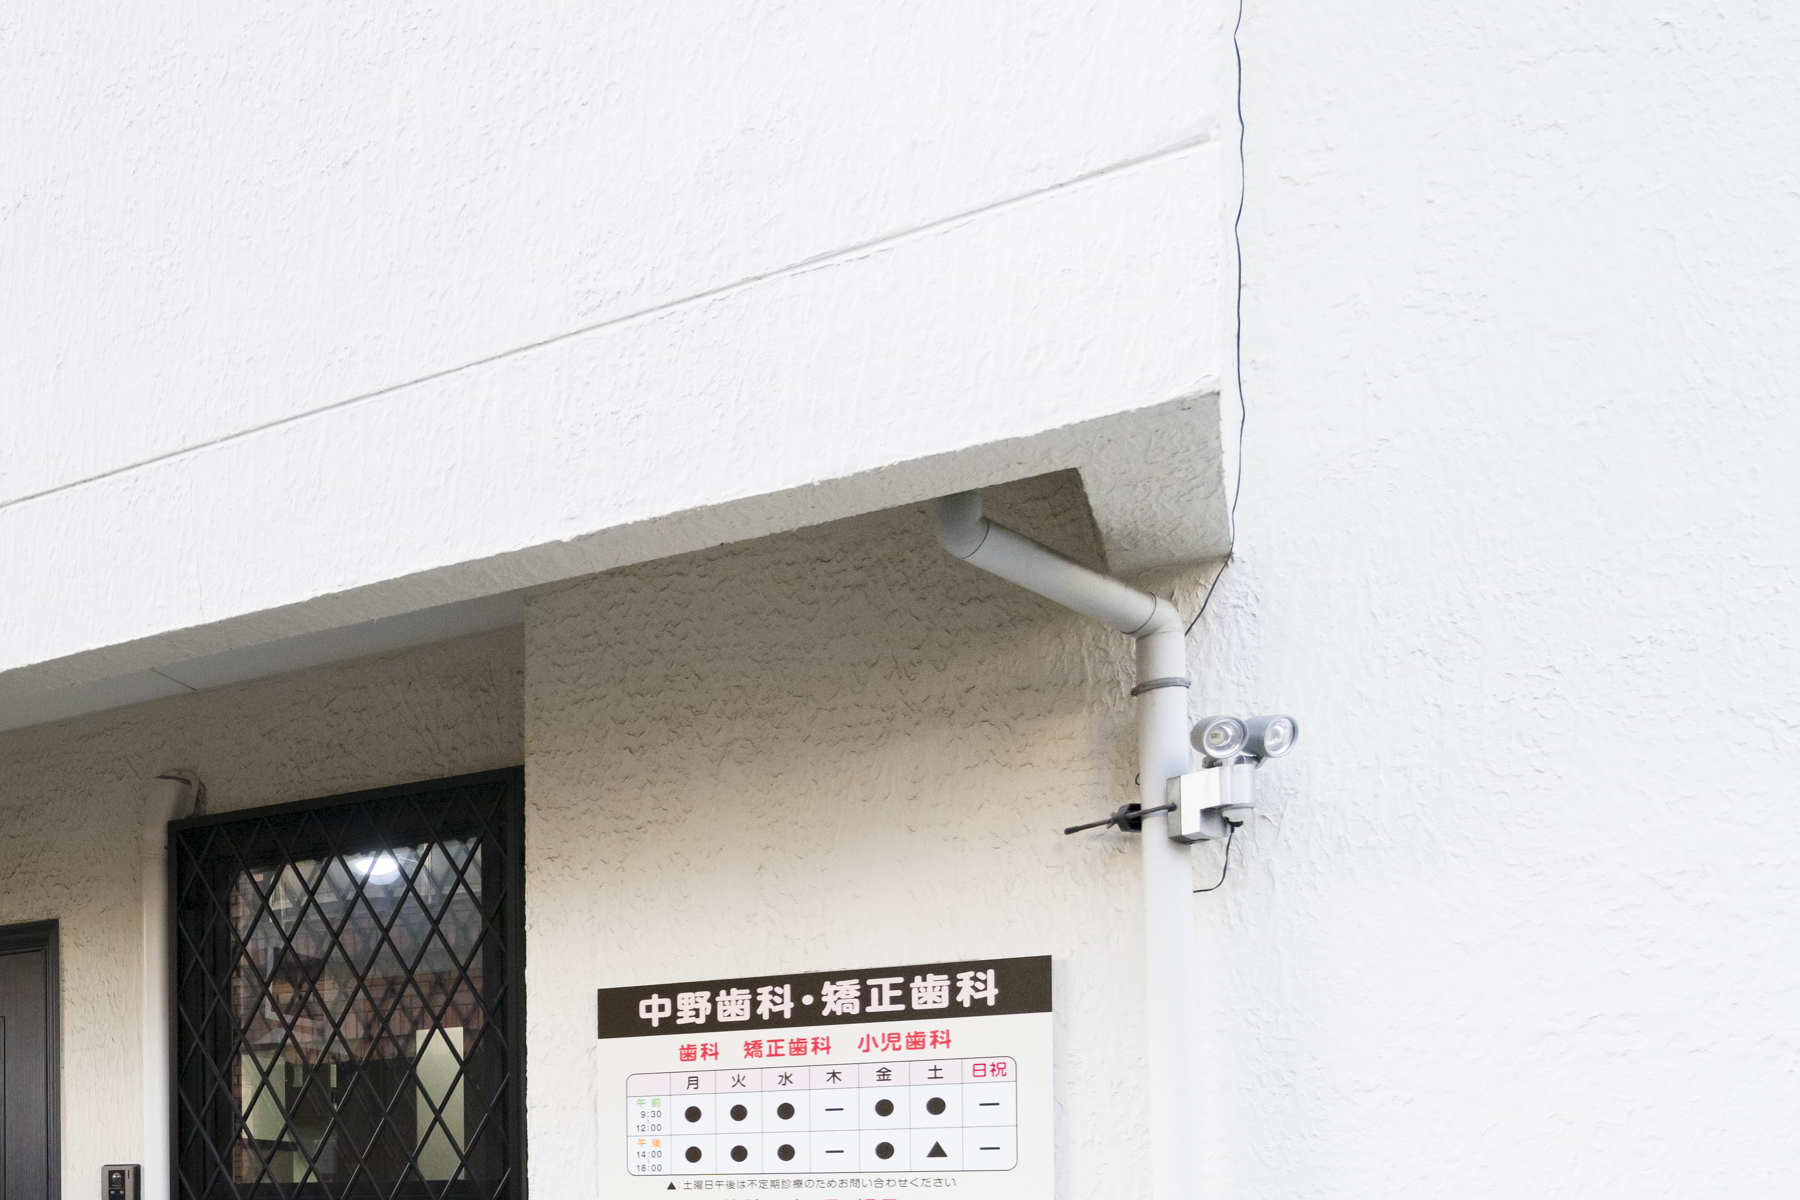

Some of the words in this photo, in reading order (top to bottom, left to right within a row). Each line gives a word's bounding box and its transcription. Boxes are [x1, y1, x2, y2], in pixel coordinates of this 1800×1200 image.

[638, 968, 999, 1027] 中野歯科・矯正歯科
[678, 1041, 720, 1062] 歯科
[742, 1036, 832, 1060] 矯正歯科
[857, 1029, 952, 1053] 小児歯科
[685, 1075, 700, 1090] 月
[730, 1073, 747, 1088] 火
[777, 1071, 794, 1086] 水
[825, 1068, 843, 1084] 木
[875, 1066, 893, 1082] 金
[927, 1064, 944, 1080] 土
[972, 1061, 1007, 1079] 日祝
[640, 1110, 662, 1118] 9:30
[636, 1124, 662, 1132] 12:00
[636, 1150, 662, 1158] 14:00
[636, 1164, 662, 1172] 18:00
